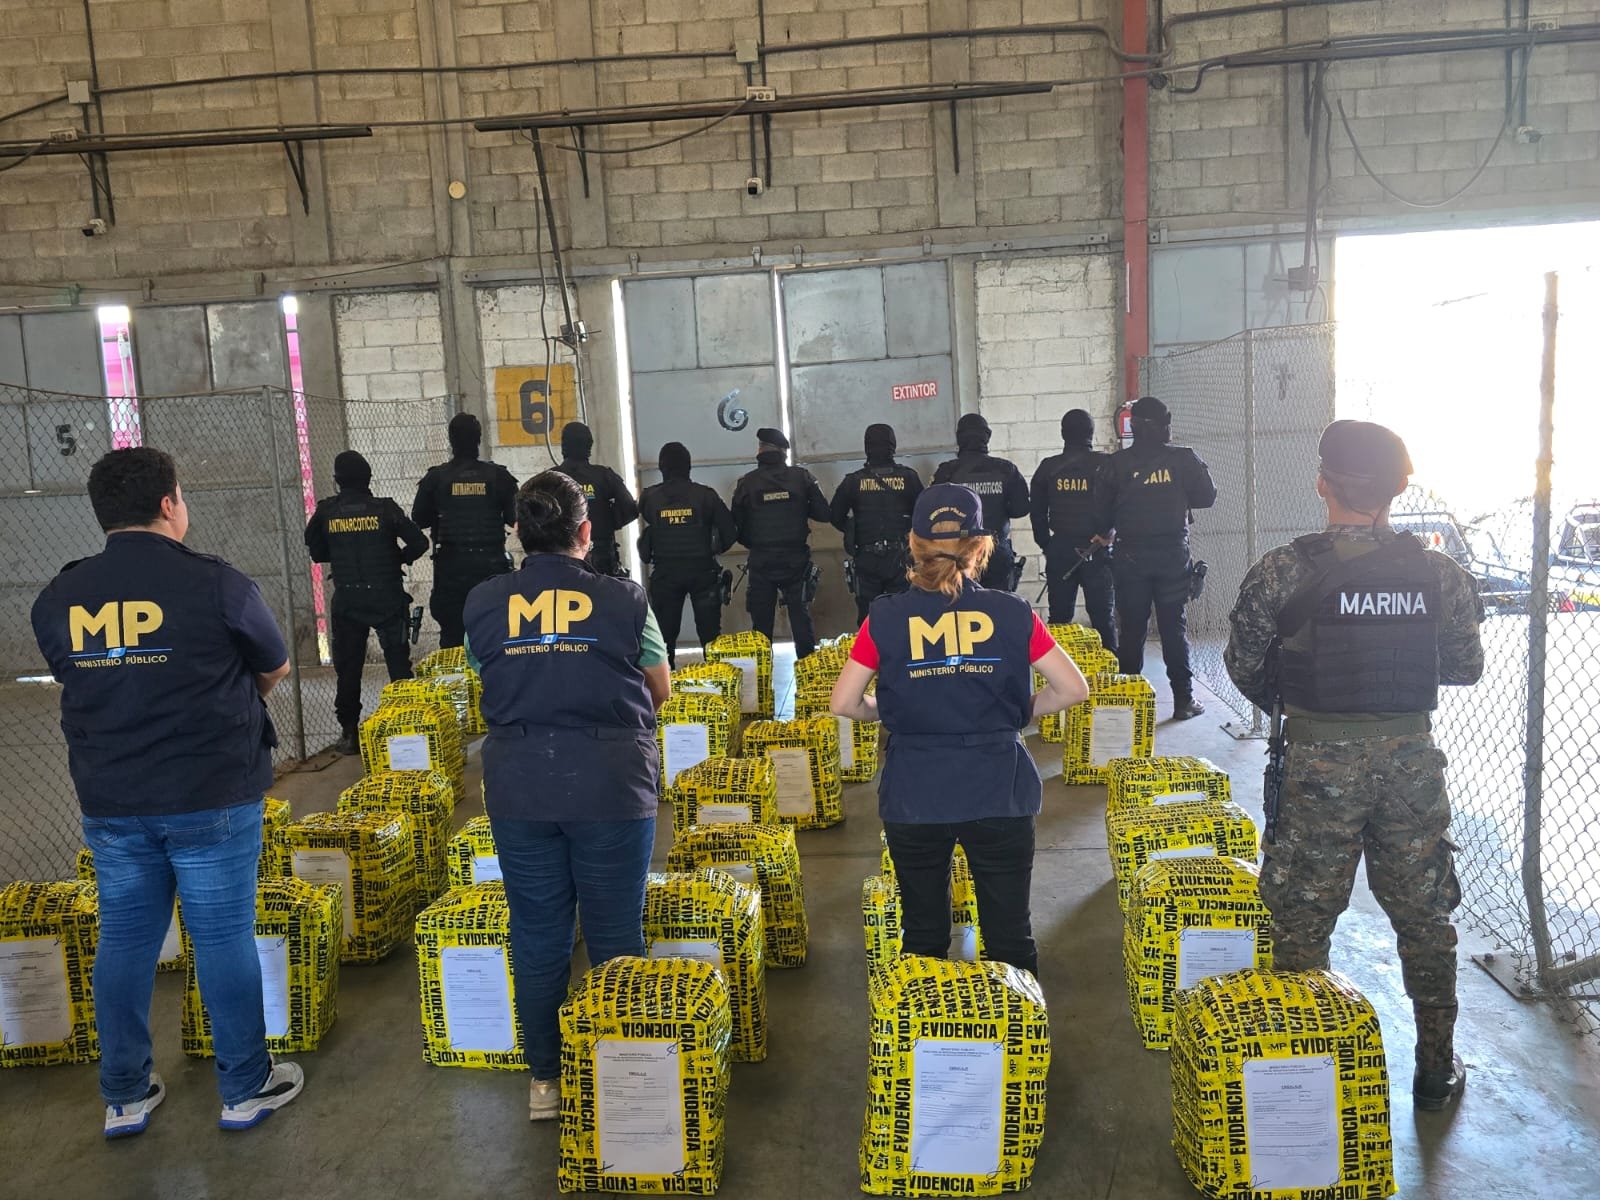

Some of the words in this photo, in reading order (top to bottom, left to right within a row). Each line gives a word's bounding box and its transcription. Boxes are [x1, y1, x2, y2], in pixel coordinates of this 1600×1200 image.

[520, 380, 555, 435] 6
[893, 383, 936, 400] EXTINTOR
[717, 388, 749, 431] 6
[55, 424, 77, 456] 5
[1057, 479, 1088, 491] SGAIA
[1134, 469, 1171, 485] AIA
[328, 516, 379, 533] ANTINARCOTICOS
[508, 588, 593, 638] MP
[1340, 591, 1427, 615] MARINA
[69, 601, 163, 651] MP
[908, 611, 994, 660] MP
[74, 658, 122, 668] MINISTERIO
[125, 655, 168, 665] PÚBLICO
[505, 644, 550, 656] MINISTERIO
[553, 641, 589, 653] PÚBLICO
[909, 665, 956, 679] MINISTERIO
[959, 662, 994, 673] PÚBLICO
[1097, 698, 1134, 706] EVIDENCIA
[1134, 709, 1143, 746] EVIDENCIA
[1081, 727, 1090, 764] EVIDENCIA
[352, 868, 364, 919] EVIDENCIA
[1198, 900, 1263, 911] EVIDENCIA
[663, 926, 717, 939] VIDENCIA
[65, 946, 82, 1003] EVIDENCIA
[1162, 953, 1176, 1013] EVIDENCIA
[290, 985, 303, 1042] EVIDENCIA
[429, 980, 446, 1039] EVIDENCIA
[1007, 986, 1024, 1055] EVIDENC
[921, 1022, 998, 1039] EVIDENCIA
[1269, 1042, 1286, 1051] MP
[1009, 1059, 1017, 1074] MP
[1227, 1057, 1236, 1073] MP
[579, 1058, 595, 1132] EVIDENCIA
[1343, 1084, 1352, 1099] MP
[683, 1078, 700, 1152] EVIDENCIA
[893, 1078, 911, 1153] EVIDENCIA
[1003, 1081, 1022, 1156] EVIDENCIA
[1226, 1080, 1246, 1156] EVIDENCIA
[1342, 1106, 1360, 1181] EVIDENCIA
[896, 1156, 904, 1172] MP
[1234, 1159, 1242, 1173] MP
[909, 1175, 975, 1192] VIDENCIA
